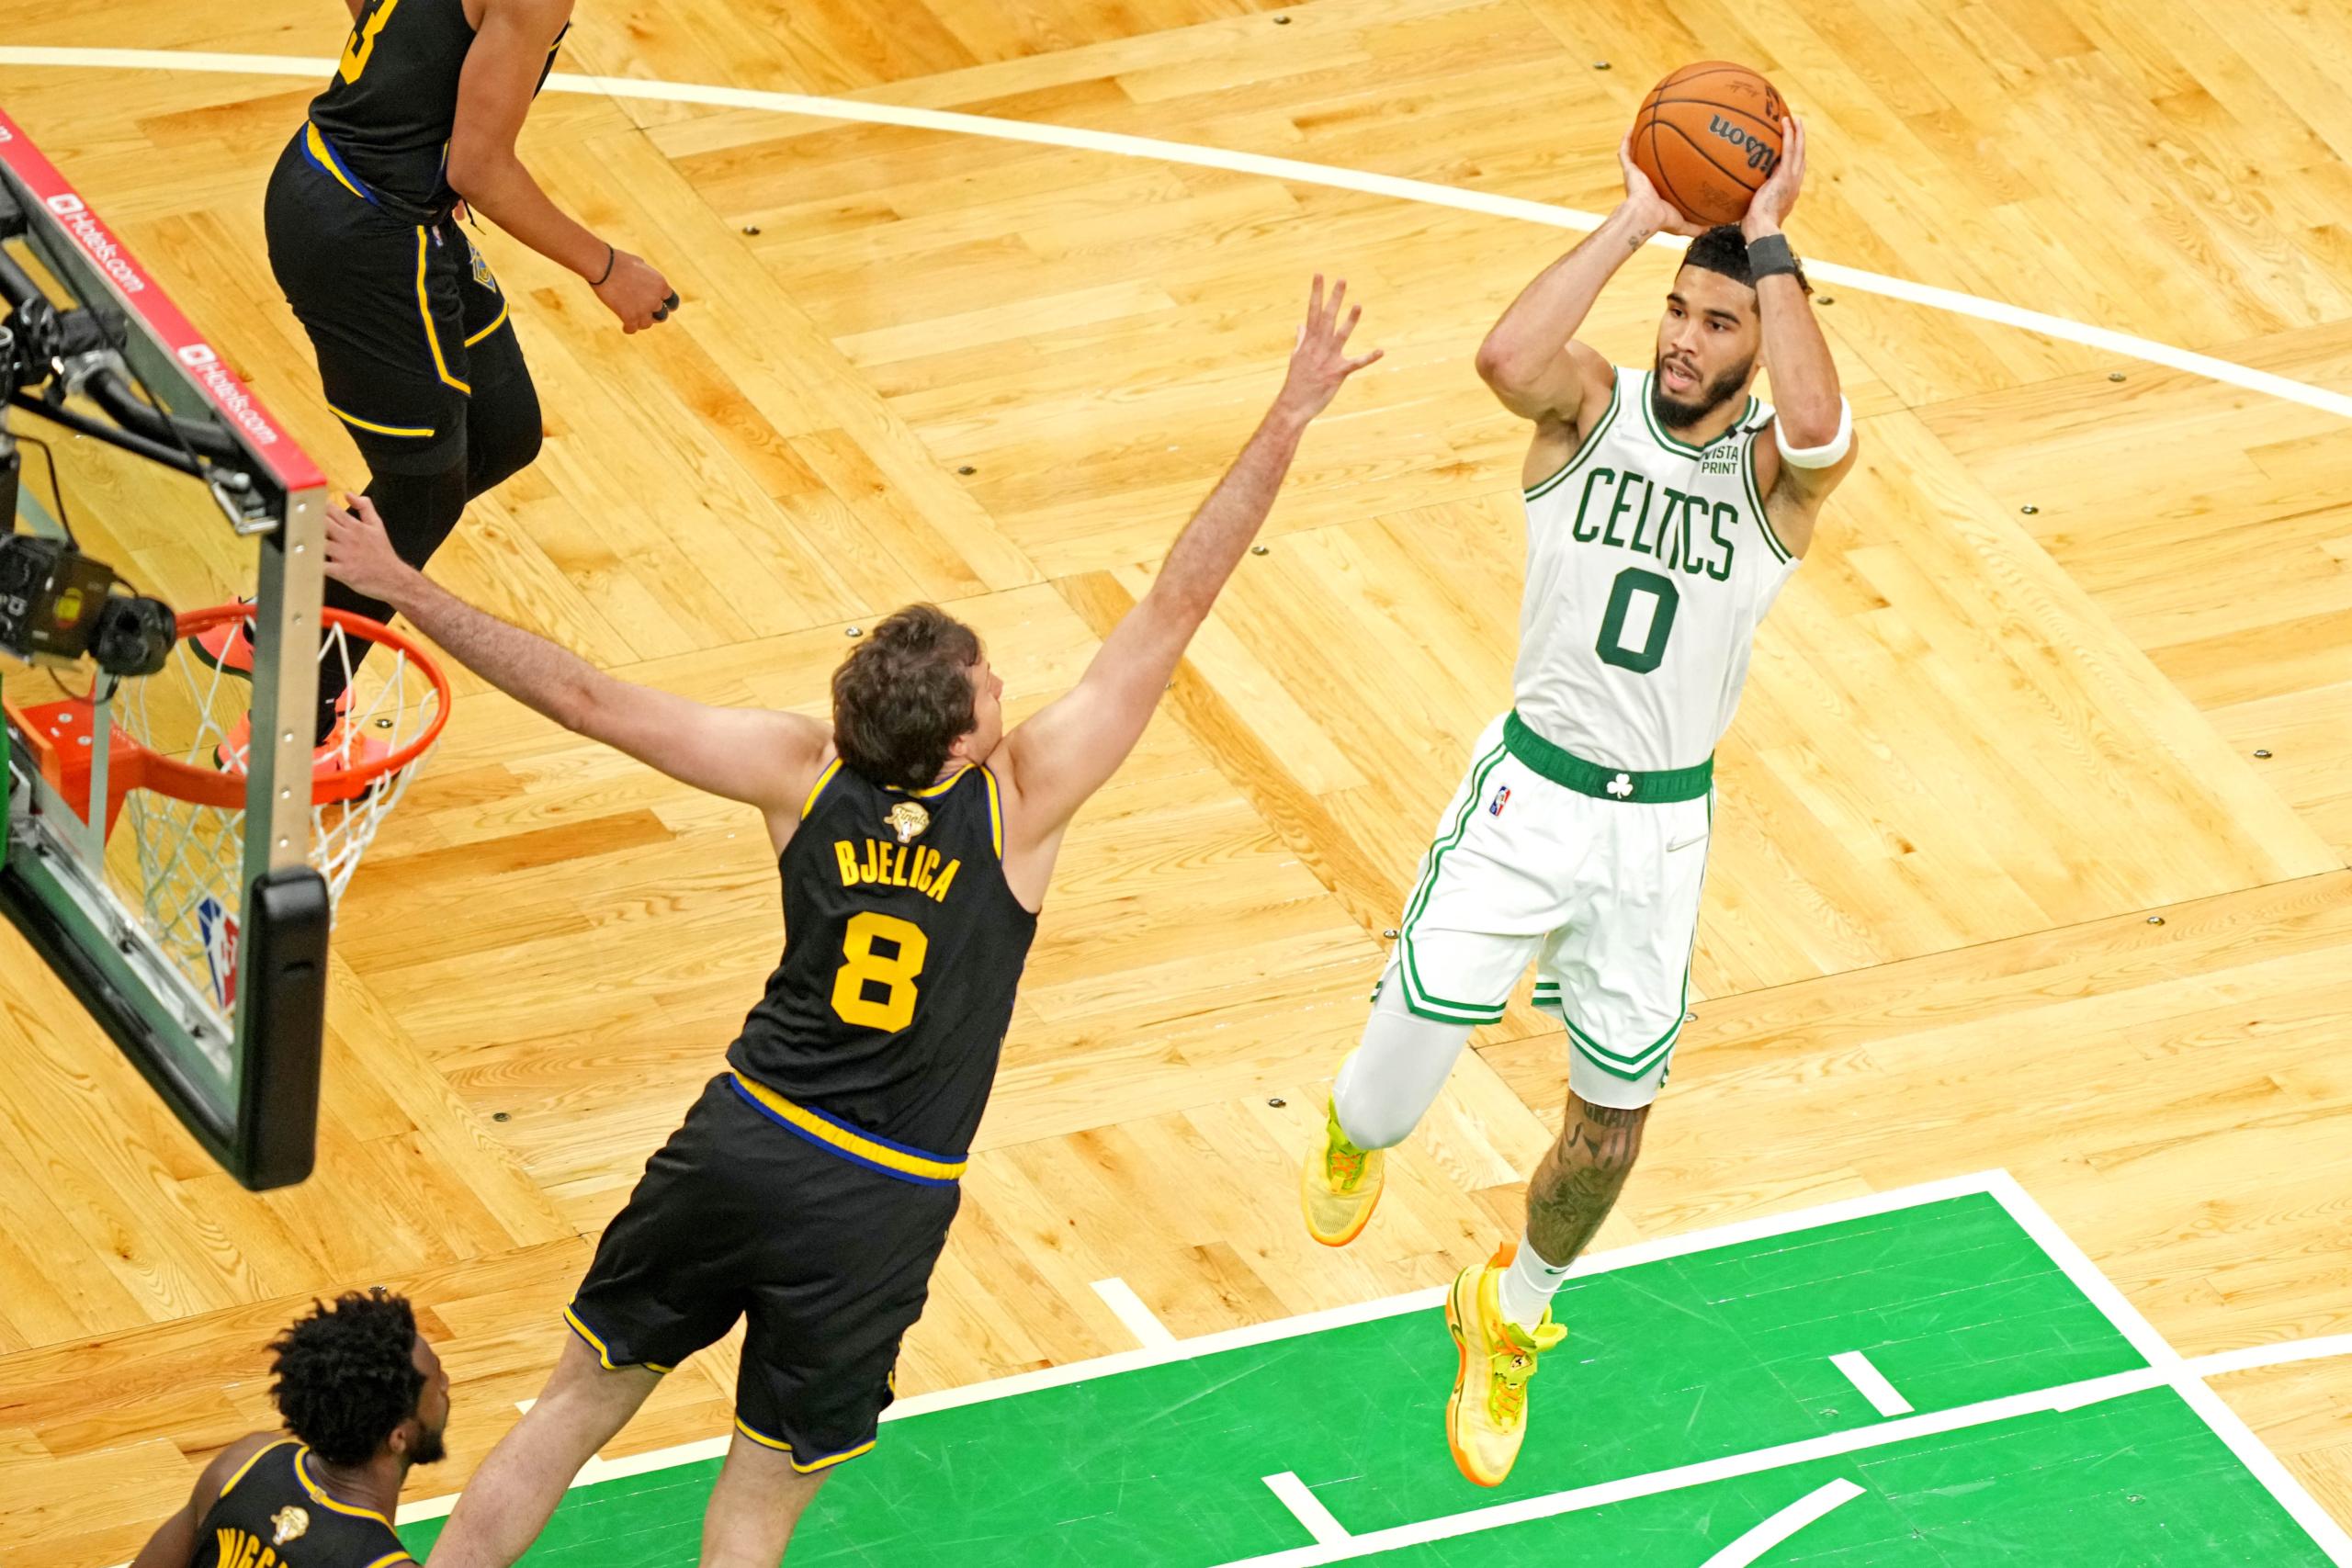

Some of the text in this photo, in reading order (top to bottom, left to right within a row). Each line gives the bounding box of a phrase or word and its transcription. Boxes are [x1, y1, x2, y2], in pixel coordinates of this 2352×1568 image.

[64, 210, 144, 293] Hotels.com
[195, 361, 277, 445] Hotels.com
[1702, 446, 1738, 461] VISTA
[1702, 461, 1737, 475] PRINT
[1595, 567, 1679, 674] 0
[833, 838, 961, 903] BJELICA
[831, 910, 929, 1033] 8
